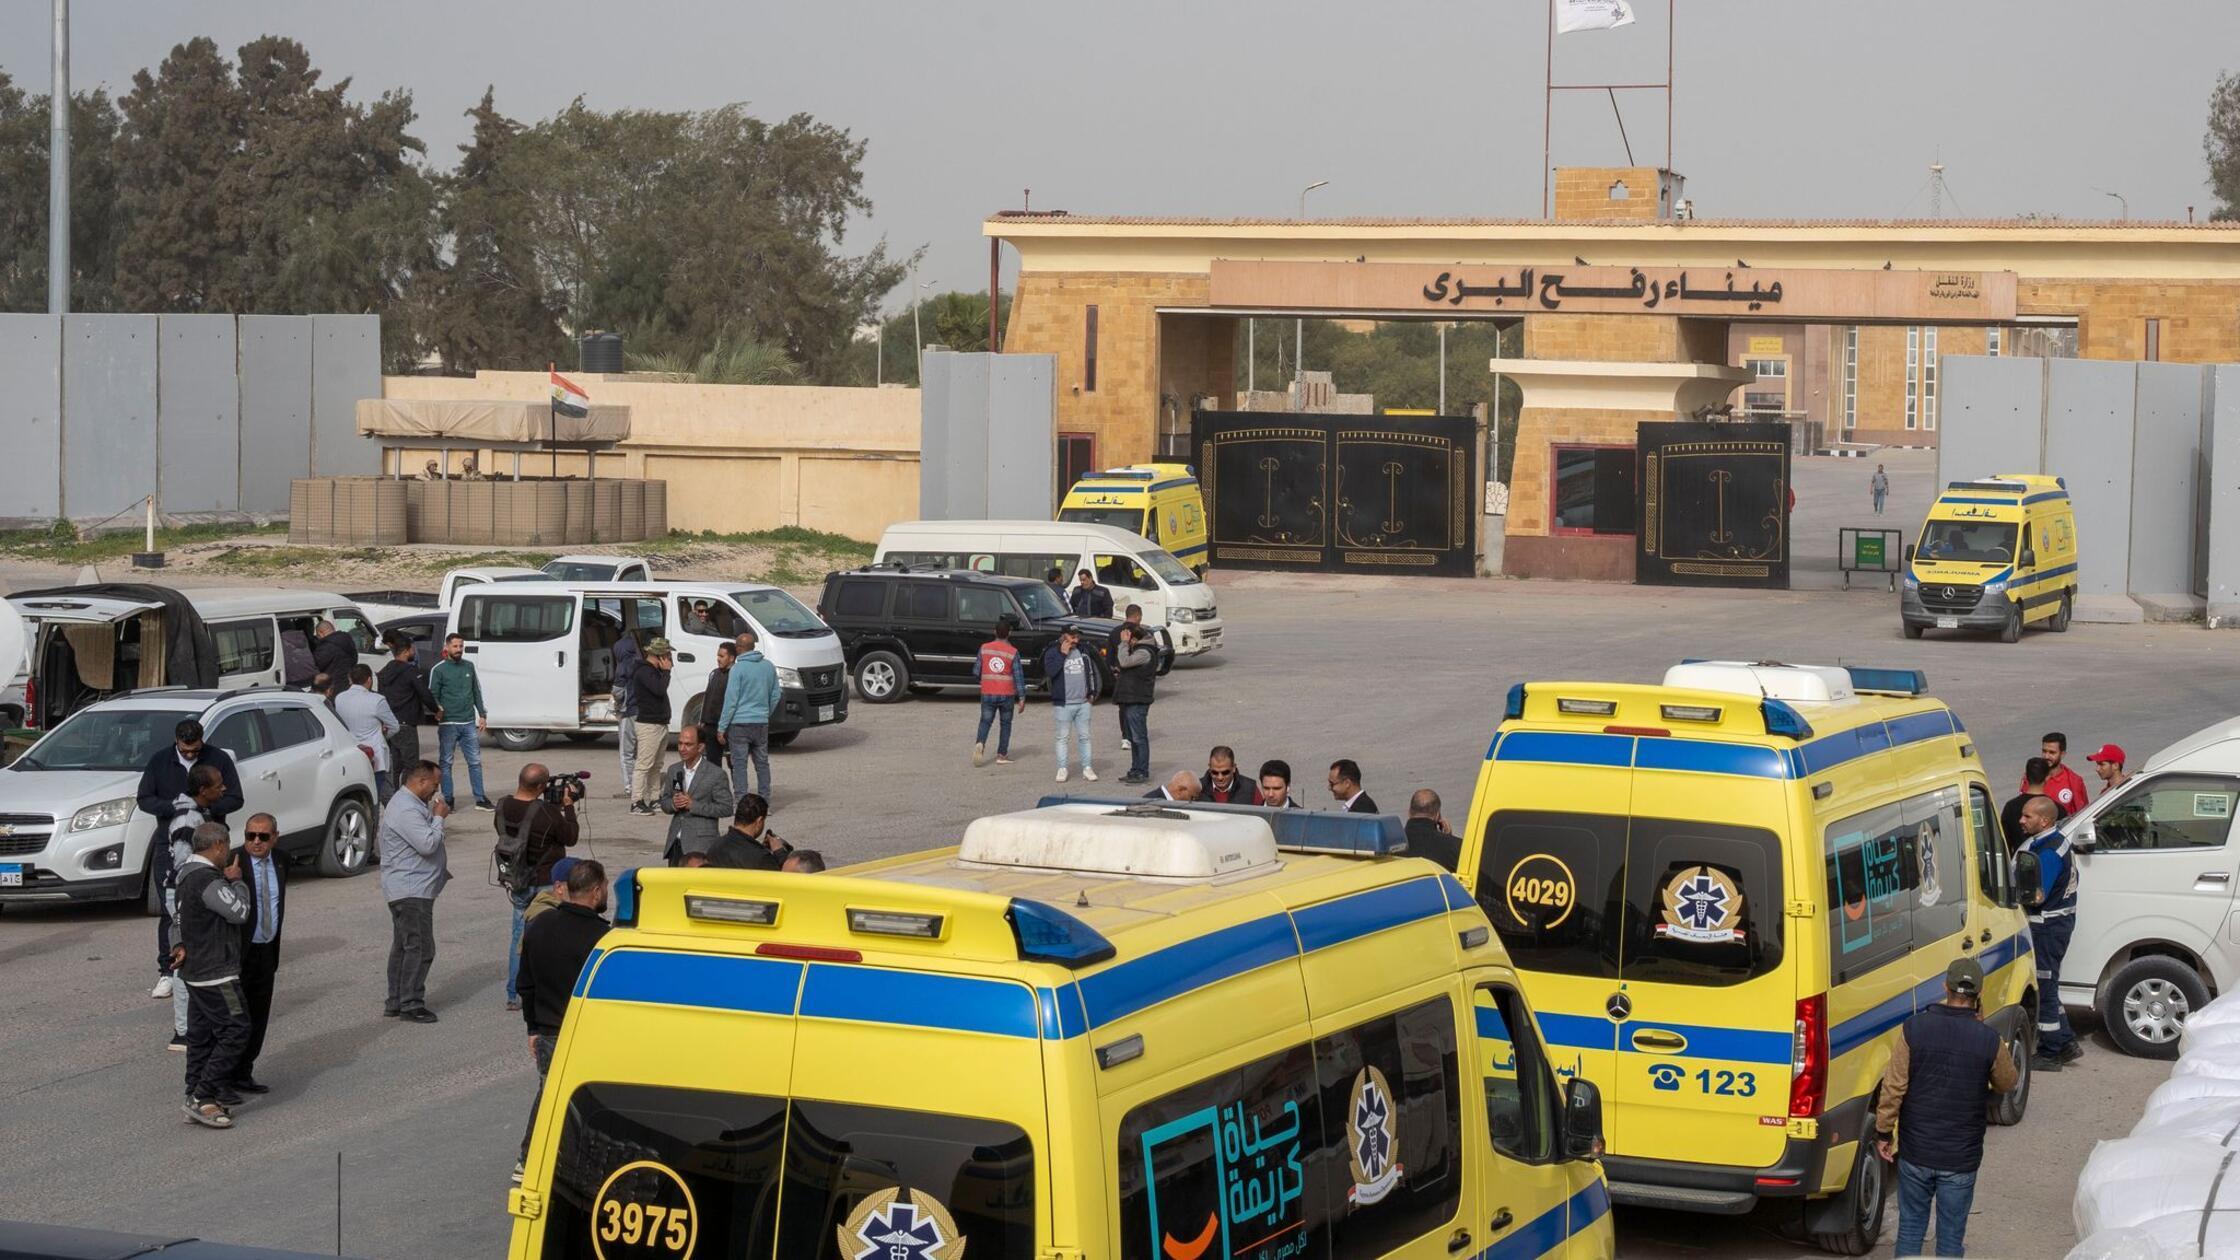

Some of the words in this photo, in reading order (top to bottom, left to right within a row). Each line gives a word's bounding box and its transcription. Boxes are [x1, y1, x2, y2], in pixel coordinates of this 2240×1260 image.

[1540, 267, 1660, 310] رفح
[1664, 271, 1782, 311] ميناء
[1511, 876, 1569, 907] 4029
[1696, 1069, 1757, 1097] 123
[1223, 1100, 1300, 1169] حياة
[1762, 1117, 1784, 1126] WAS
[1229, 1141, 1304, 1226] كريمة
[600, 1200, 688, 1251] 3975
